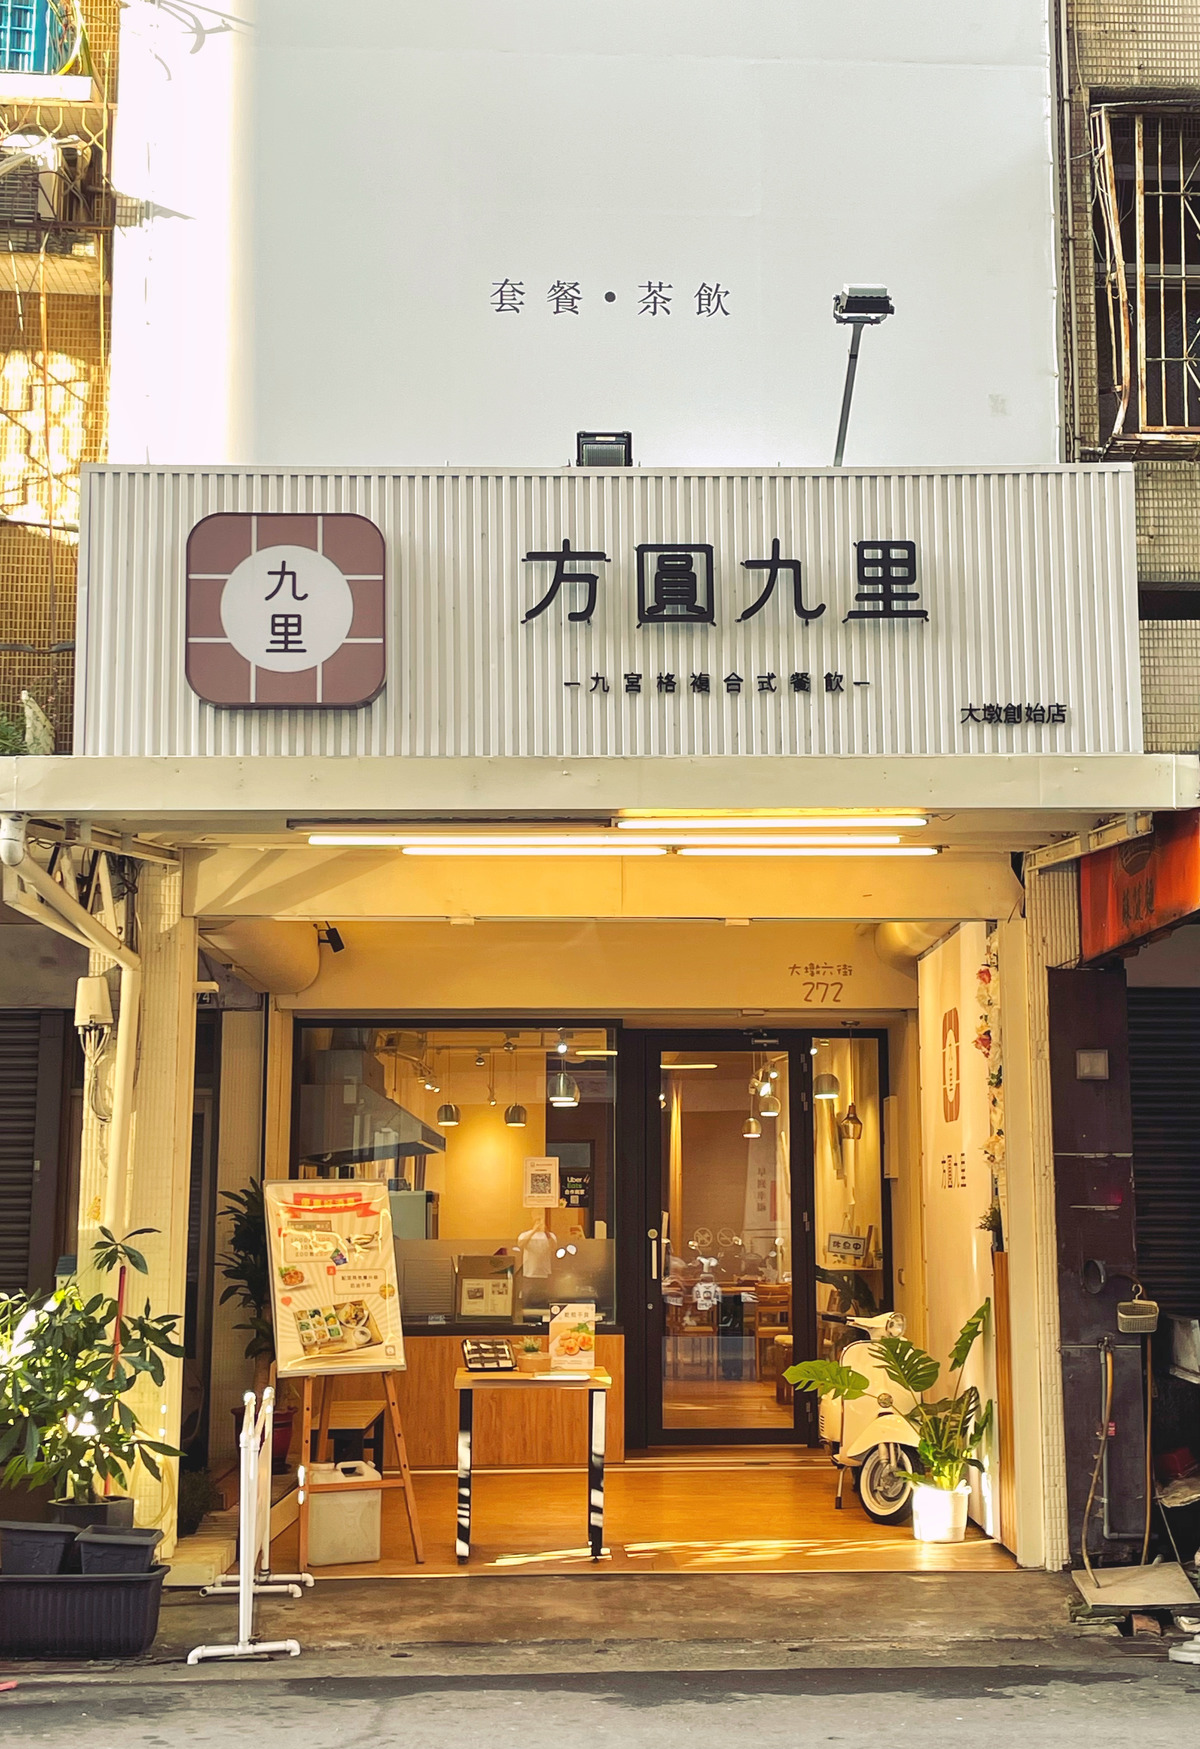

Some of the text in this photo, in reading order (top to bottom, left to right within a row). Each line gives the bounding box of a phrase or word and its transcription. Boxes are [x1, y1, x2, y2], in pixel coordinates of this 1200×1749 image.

[264, 560, 309, 653] 九里
[521, 537, 930, 628] 方圓九里
[960, 702, 1067, 724] 大墩創始店
[802, 982, 843, 1003] 272
